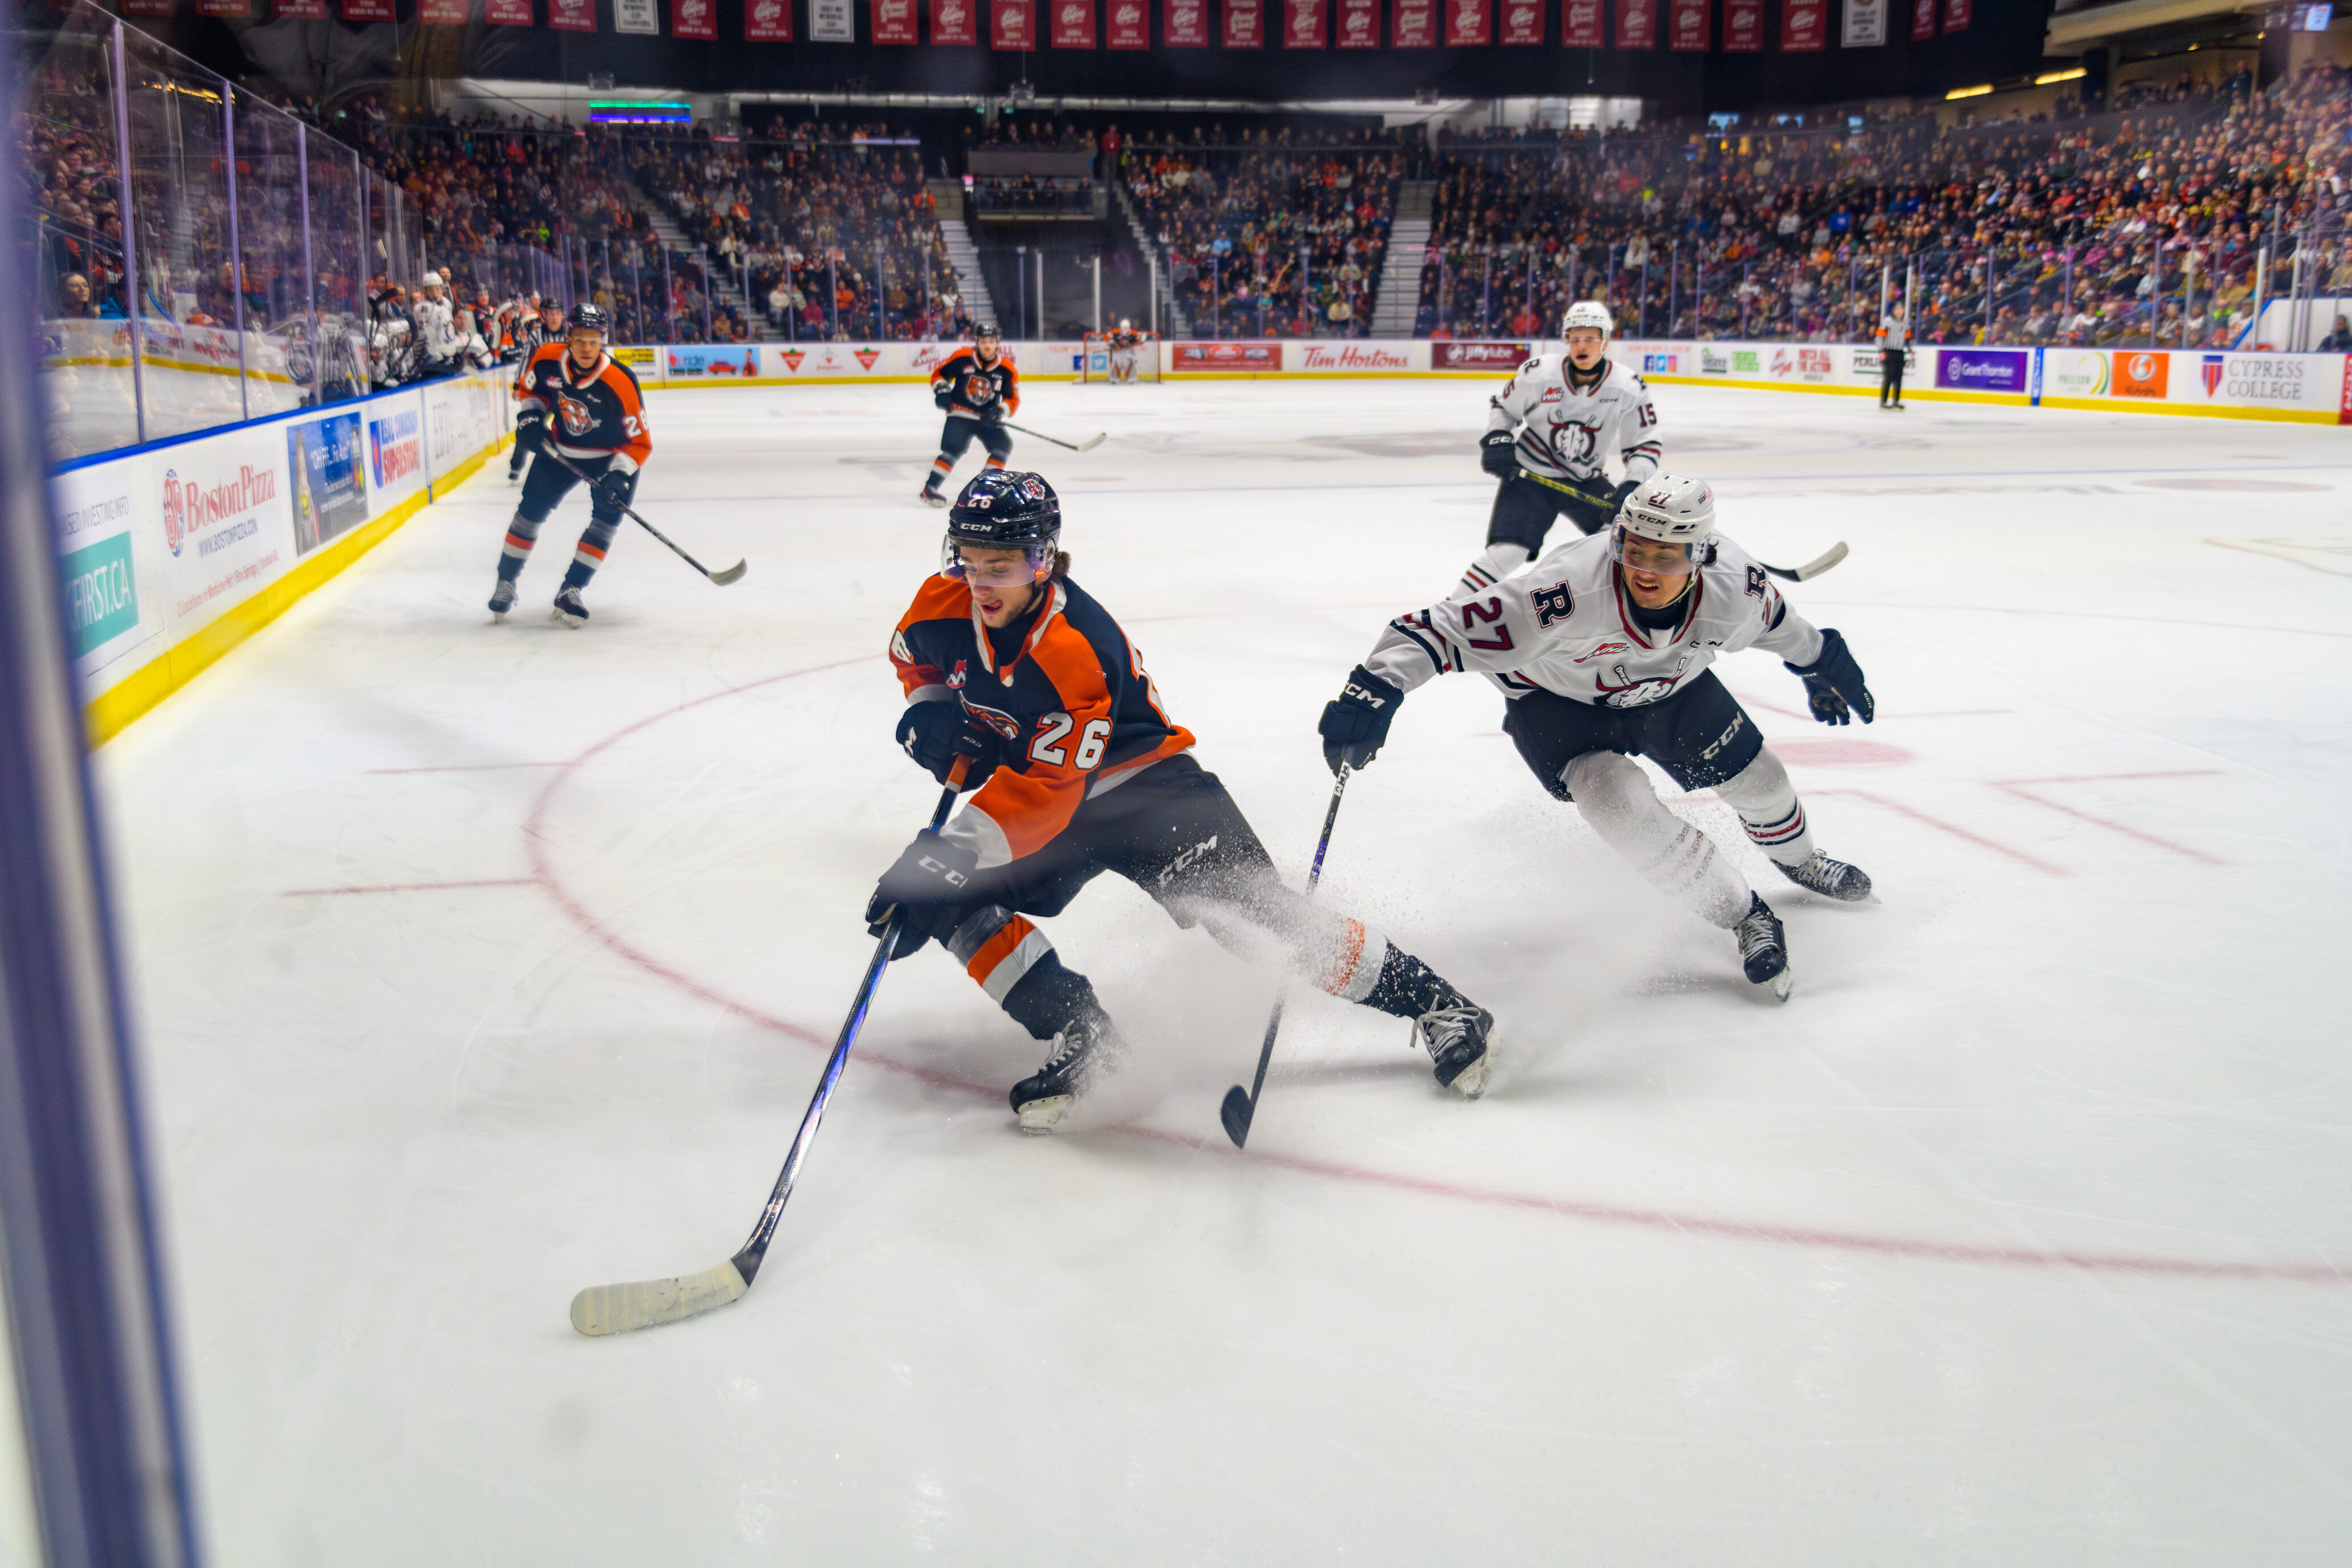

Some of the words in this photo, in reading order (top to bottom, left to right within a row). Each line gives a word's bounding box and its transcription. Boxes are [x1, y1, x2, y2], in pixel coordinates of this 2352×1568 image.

[1303, 345, 1336, 369] Tim
[1340, 346, 1408, 368] Hortons
[1961, 362, 1982, 377] Grant
[1981, 364, 2014, 378] Thornton
[2228, 358, 2305, 379] CYPRESS
[2226, 380, 2301, 400] COLLEGE
[1637, 403, 1658, 428] 15
[1488, 436, 1515, 446] CC
[383, 438, 421, 485] SUPERSTORE
[967, 495, 995, 509] 26
[1648, 491, 1672, 506] 27
[82, 499, 115, 530] INVESTING
[115, 495, 129, 519] INFO
[1637, 513, 1668, 526] CCM
[959, 522, 993, 533] CCM
[1744, 563, 1768, 603] R
[1530, 579, 1575, 629] R
[1461, 596, 1514, 652] 27
[1689, 639, 1724, 649] CM
[1342, 681, 1386, 710] CCM
[1027, 710, 1114, 771] 26
[1701, 710, 1744, 761] CCM
[1334, 761, 1351, 798] CCM
[918, 854, 969, 888] CC
[1157, 834, 1218, 890] CCM
